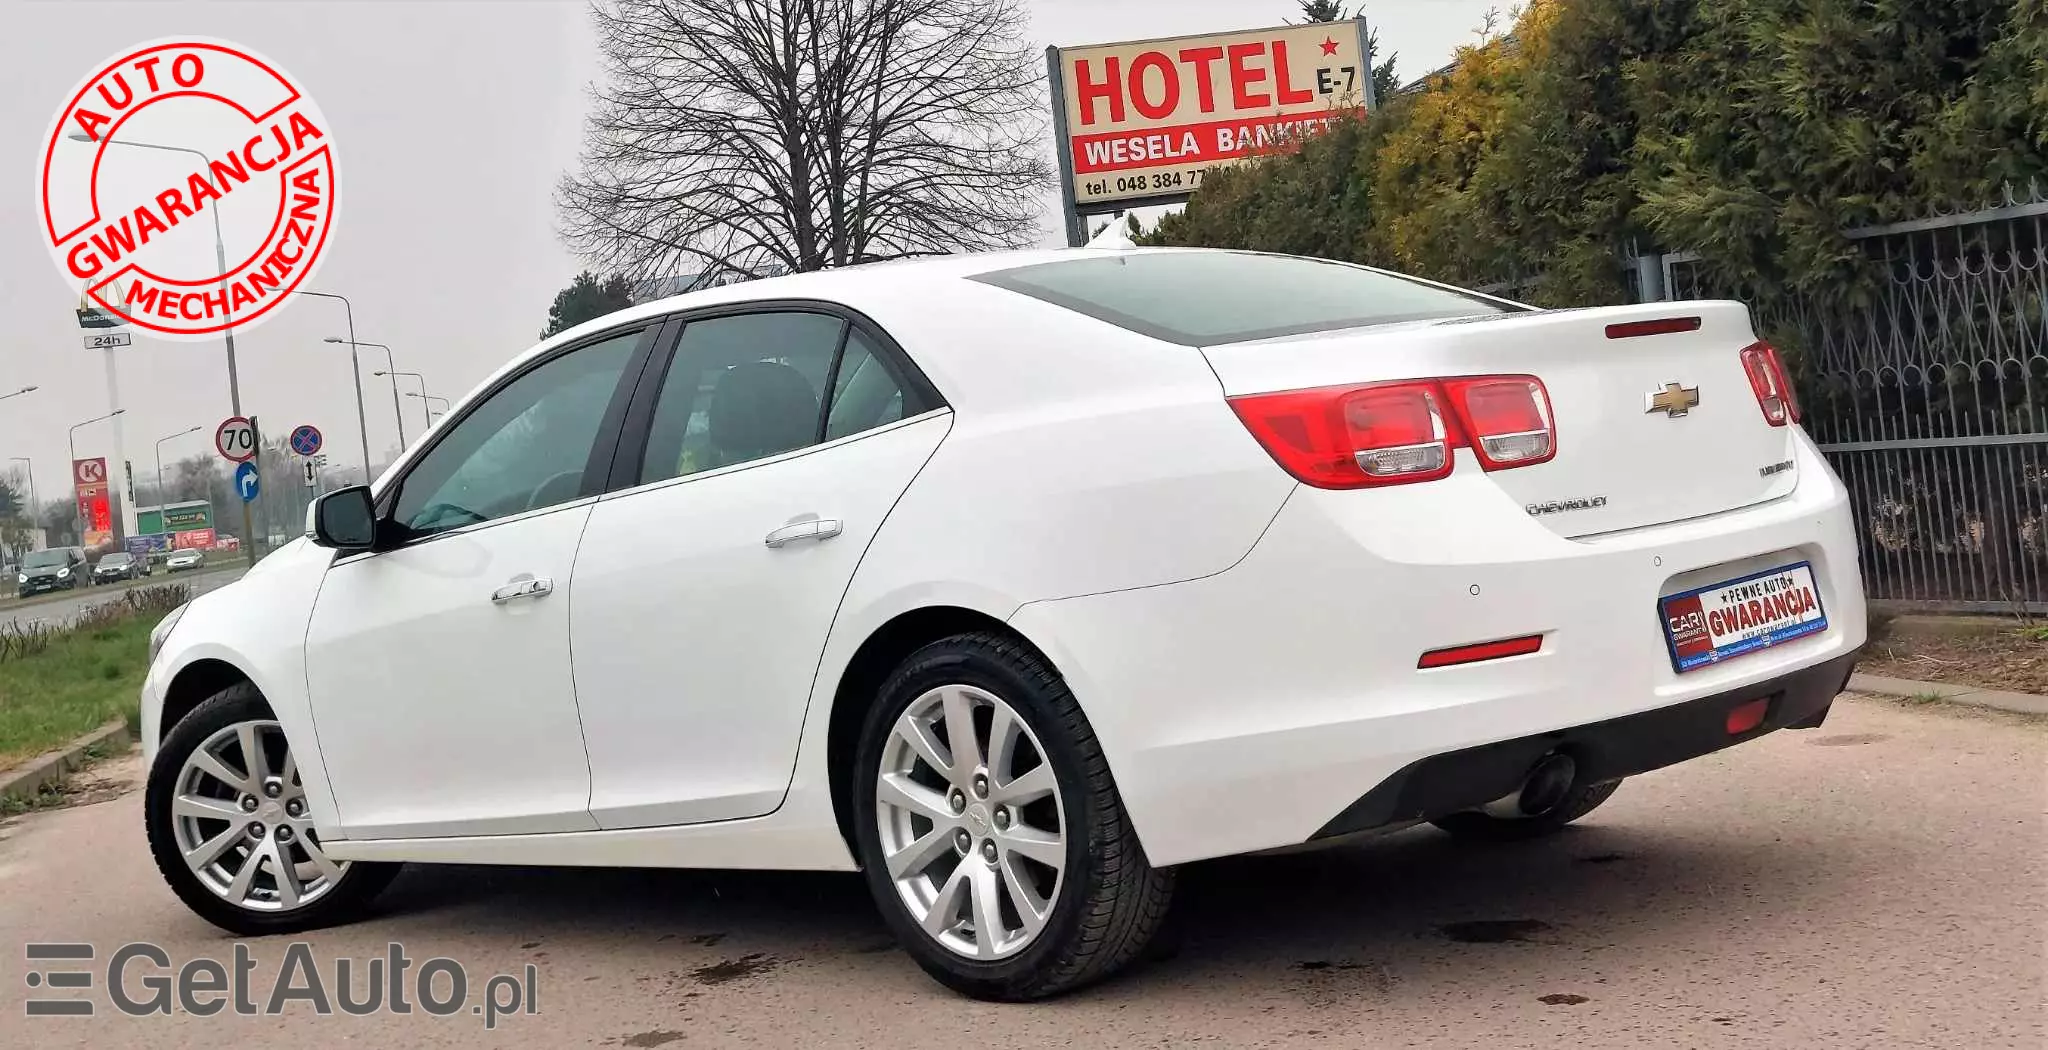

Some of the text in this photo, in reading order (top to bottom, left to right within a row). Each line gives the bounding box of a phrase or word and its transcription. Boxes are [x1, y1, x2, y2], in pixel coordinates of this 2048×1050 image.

[1074, 40, 1313, 125] HOTEL
[1316, 66, 1355, 95] E-7
[1085, 117, 1343, 166] WESELA BANKIET
[1086, 180, 1112, 195] tel.
[1116, 175, 1147, 193] 048
[1152, 172, 1182, 189] 384
[94, 336, 121, 346] 24h
[223, 428, 253, 451] 70
[84, 463, 102, 478] K
[1728, 576, 1787, 603] PEWNE AUTO
[1670, 612, 1700, 633] CAR
[1708, 586, 1817, 637] GWARANCJA
